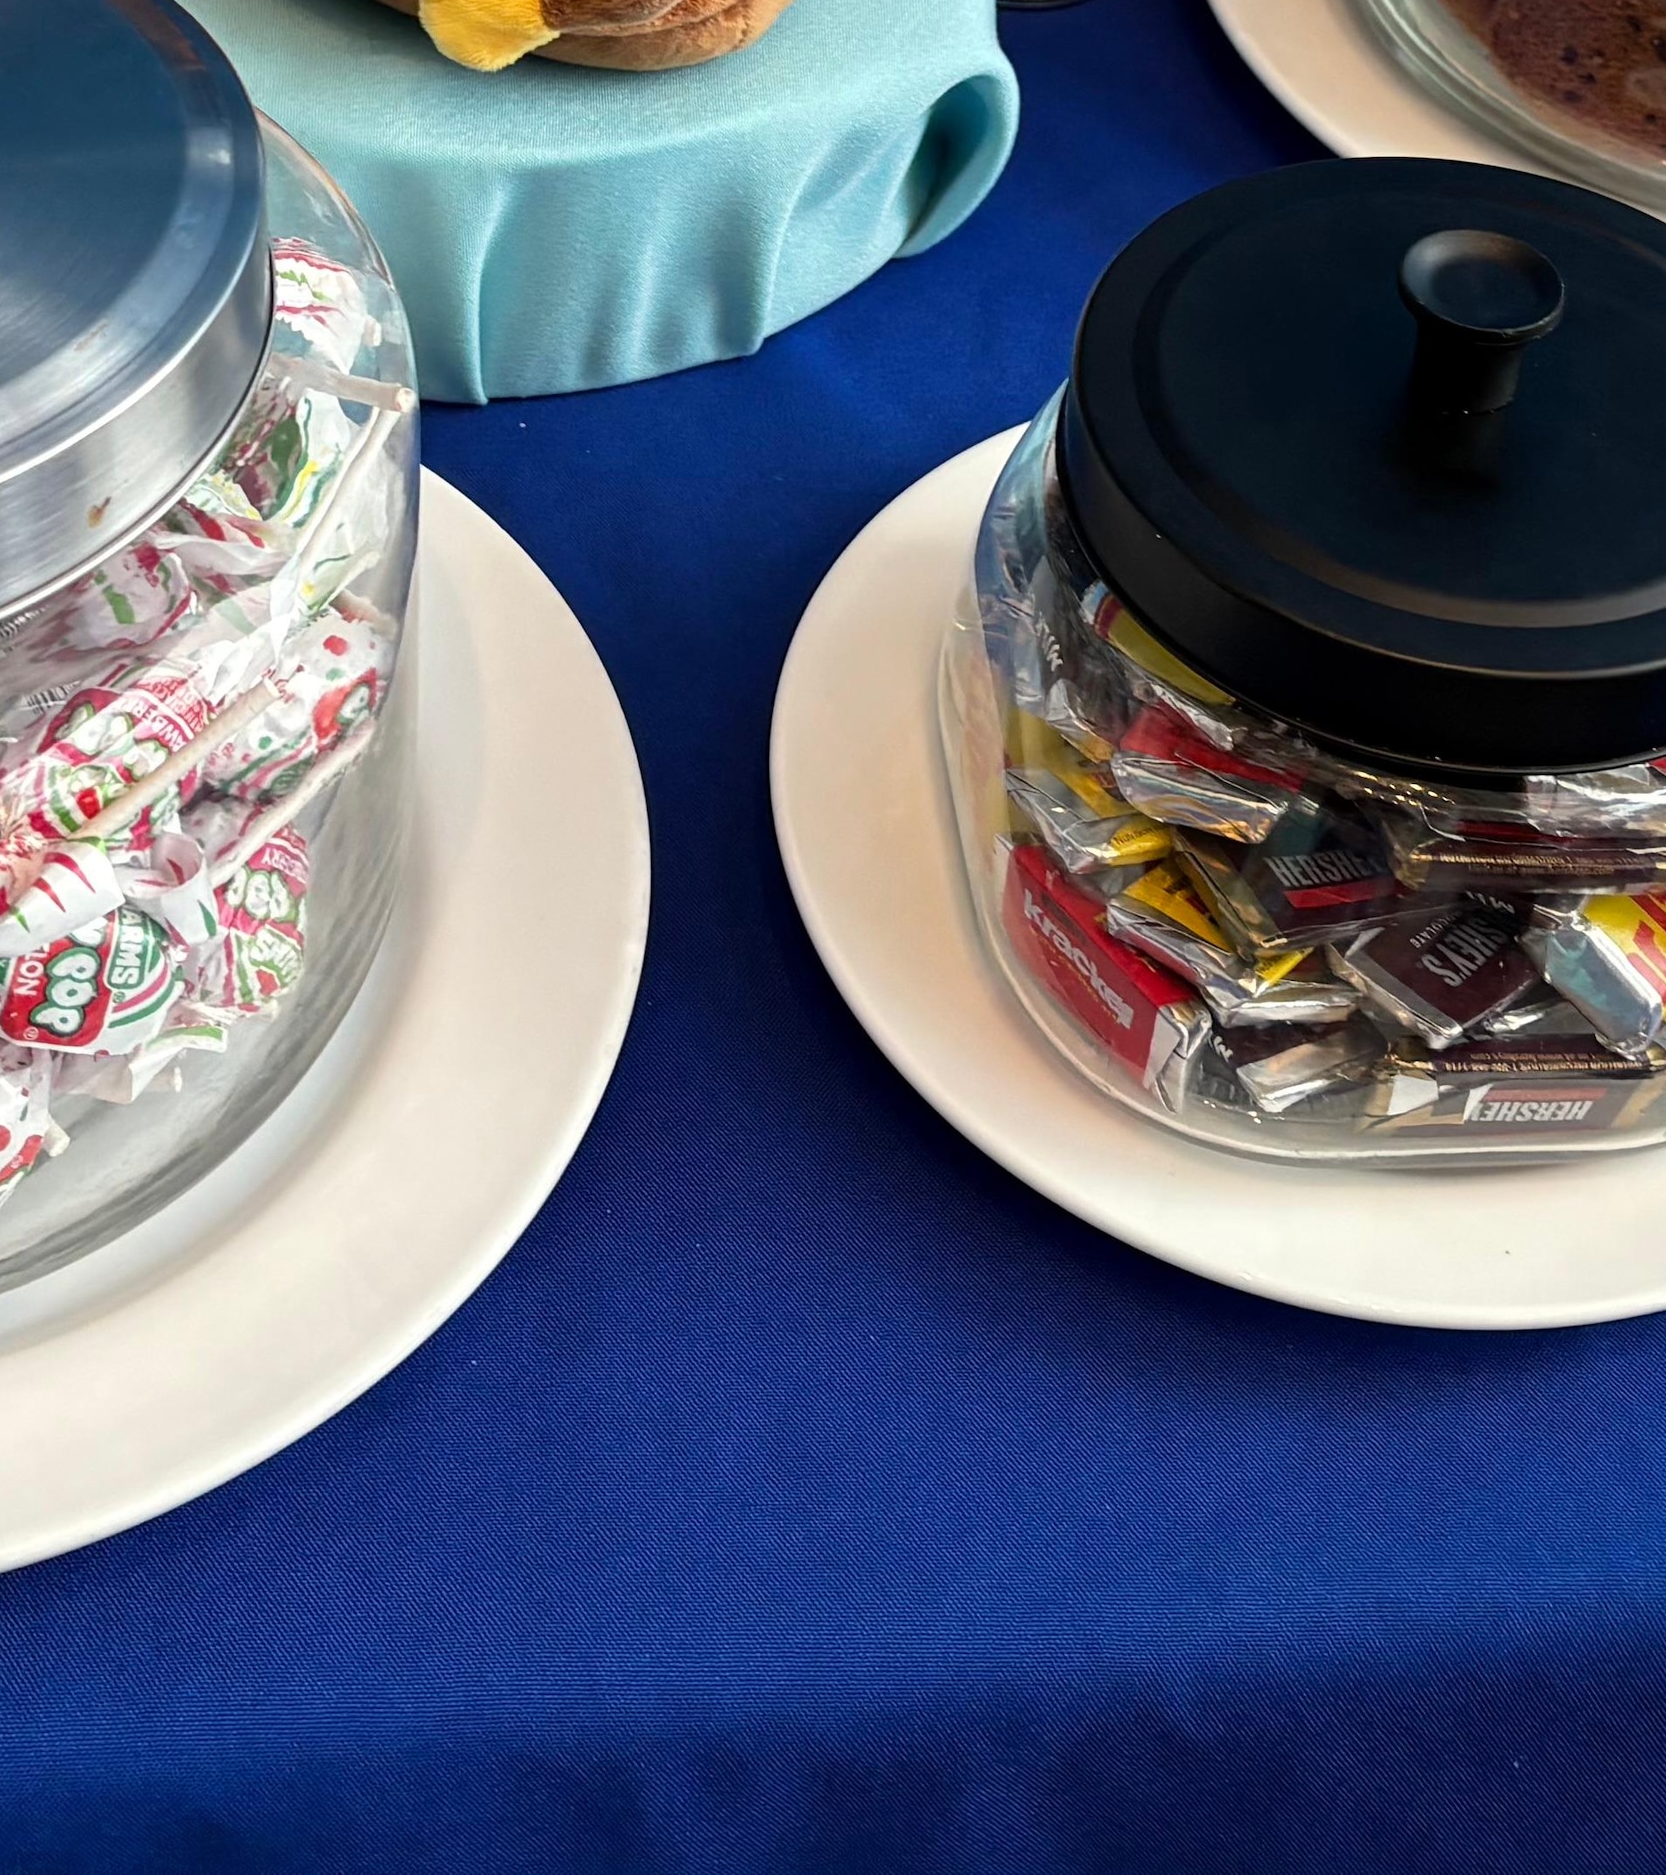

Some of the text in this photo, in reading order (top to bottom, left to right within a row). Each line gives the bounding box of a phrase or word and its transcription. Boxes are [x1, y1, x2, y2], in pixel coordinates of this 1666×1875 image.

[1264, 852, 1375, 889] HERSHE
[112, 909, 145, 988] ARMS
[31, 949, 102, 1034] POP
[1470, 1100, 1594, 1123] HERSHEY
